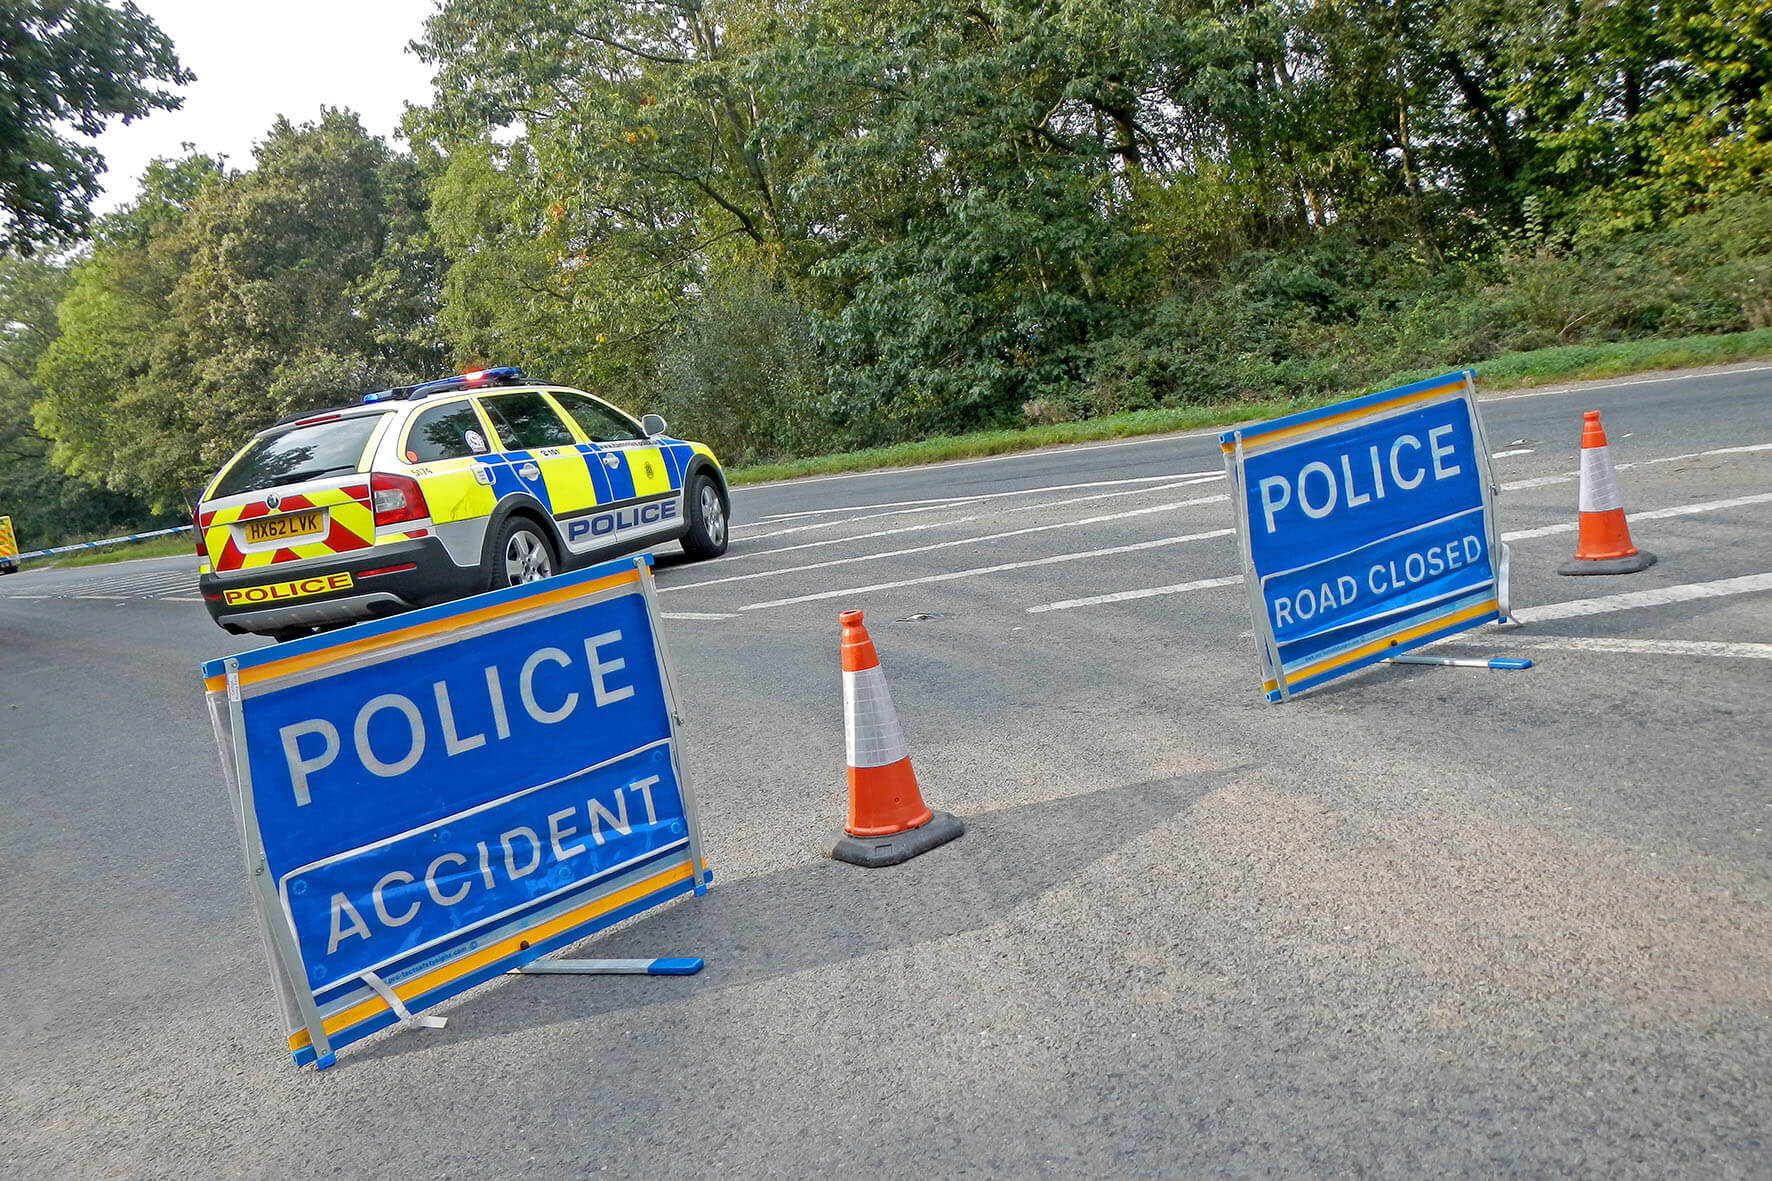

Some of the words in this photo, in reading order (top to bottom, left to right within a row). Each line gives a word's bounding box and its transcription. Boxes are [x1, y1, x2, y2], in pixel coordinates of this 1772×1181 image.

[568, 500, 676, 541] POLICE
[1259, 423, 1461, 534] POLICE
[250, 520, 286, 540] HX62
[289, 514, 317, 533] LVK
[225, 573, 353, 604] POLICE
[1275, 575, 1357, 628] ROAD
[1368, 535, 1482, 595] CLOSED
[279, 629, 635, 807] POLICE
[326, 774, 661, 955] ACCIDENT
